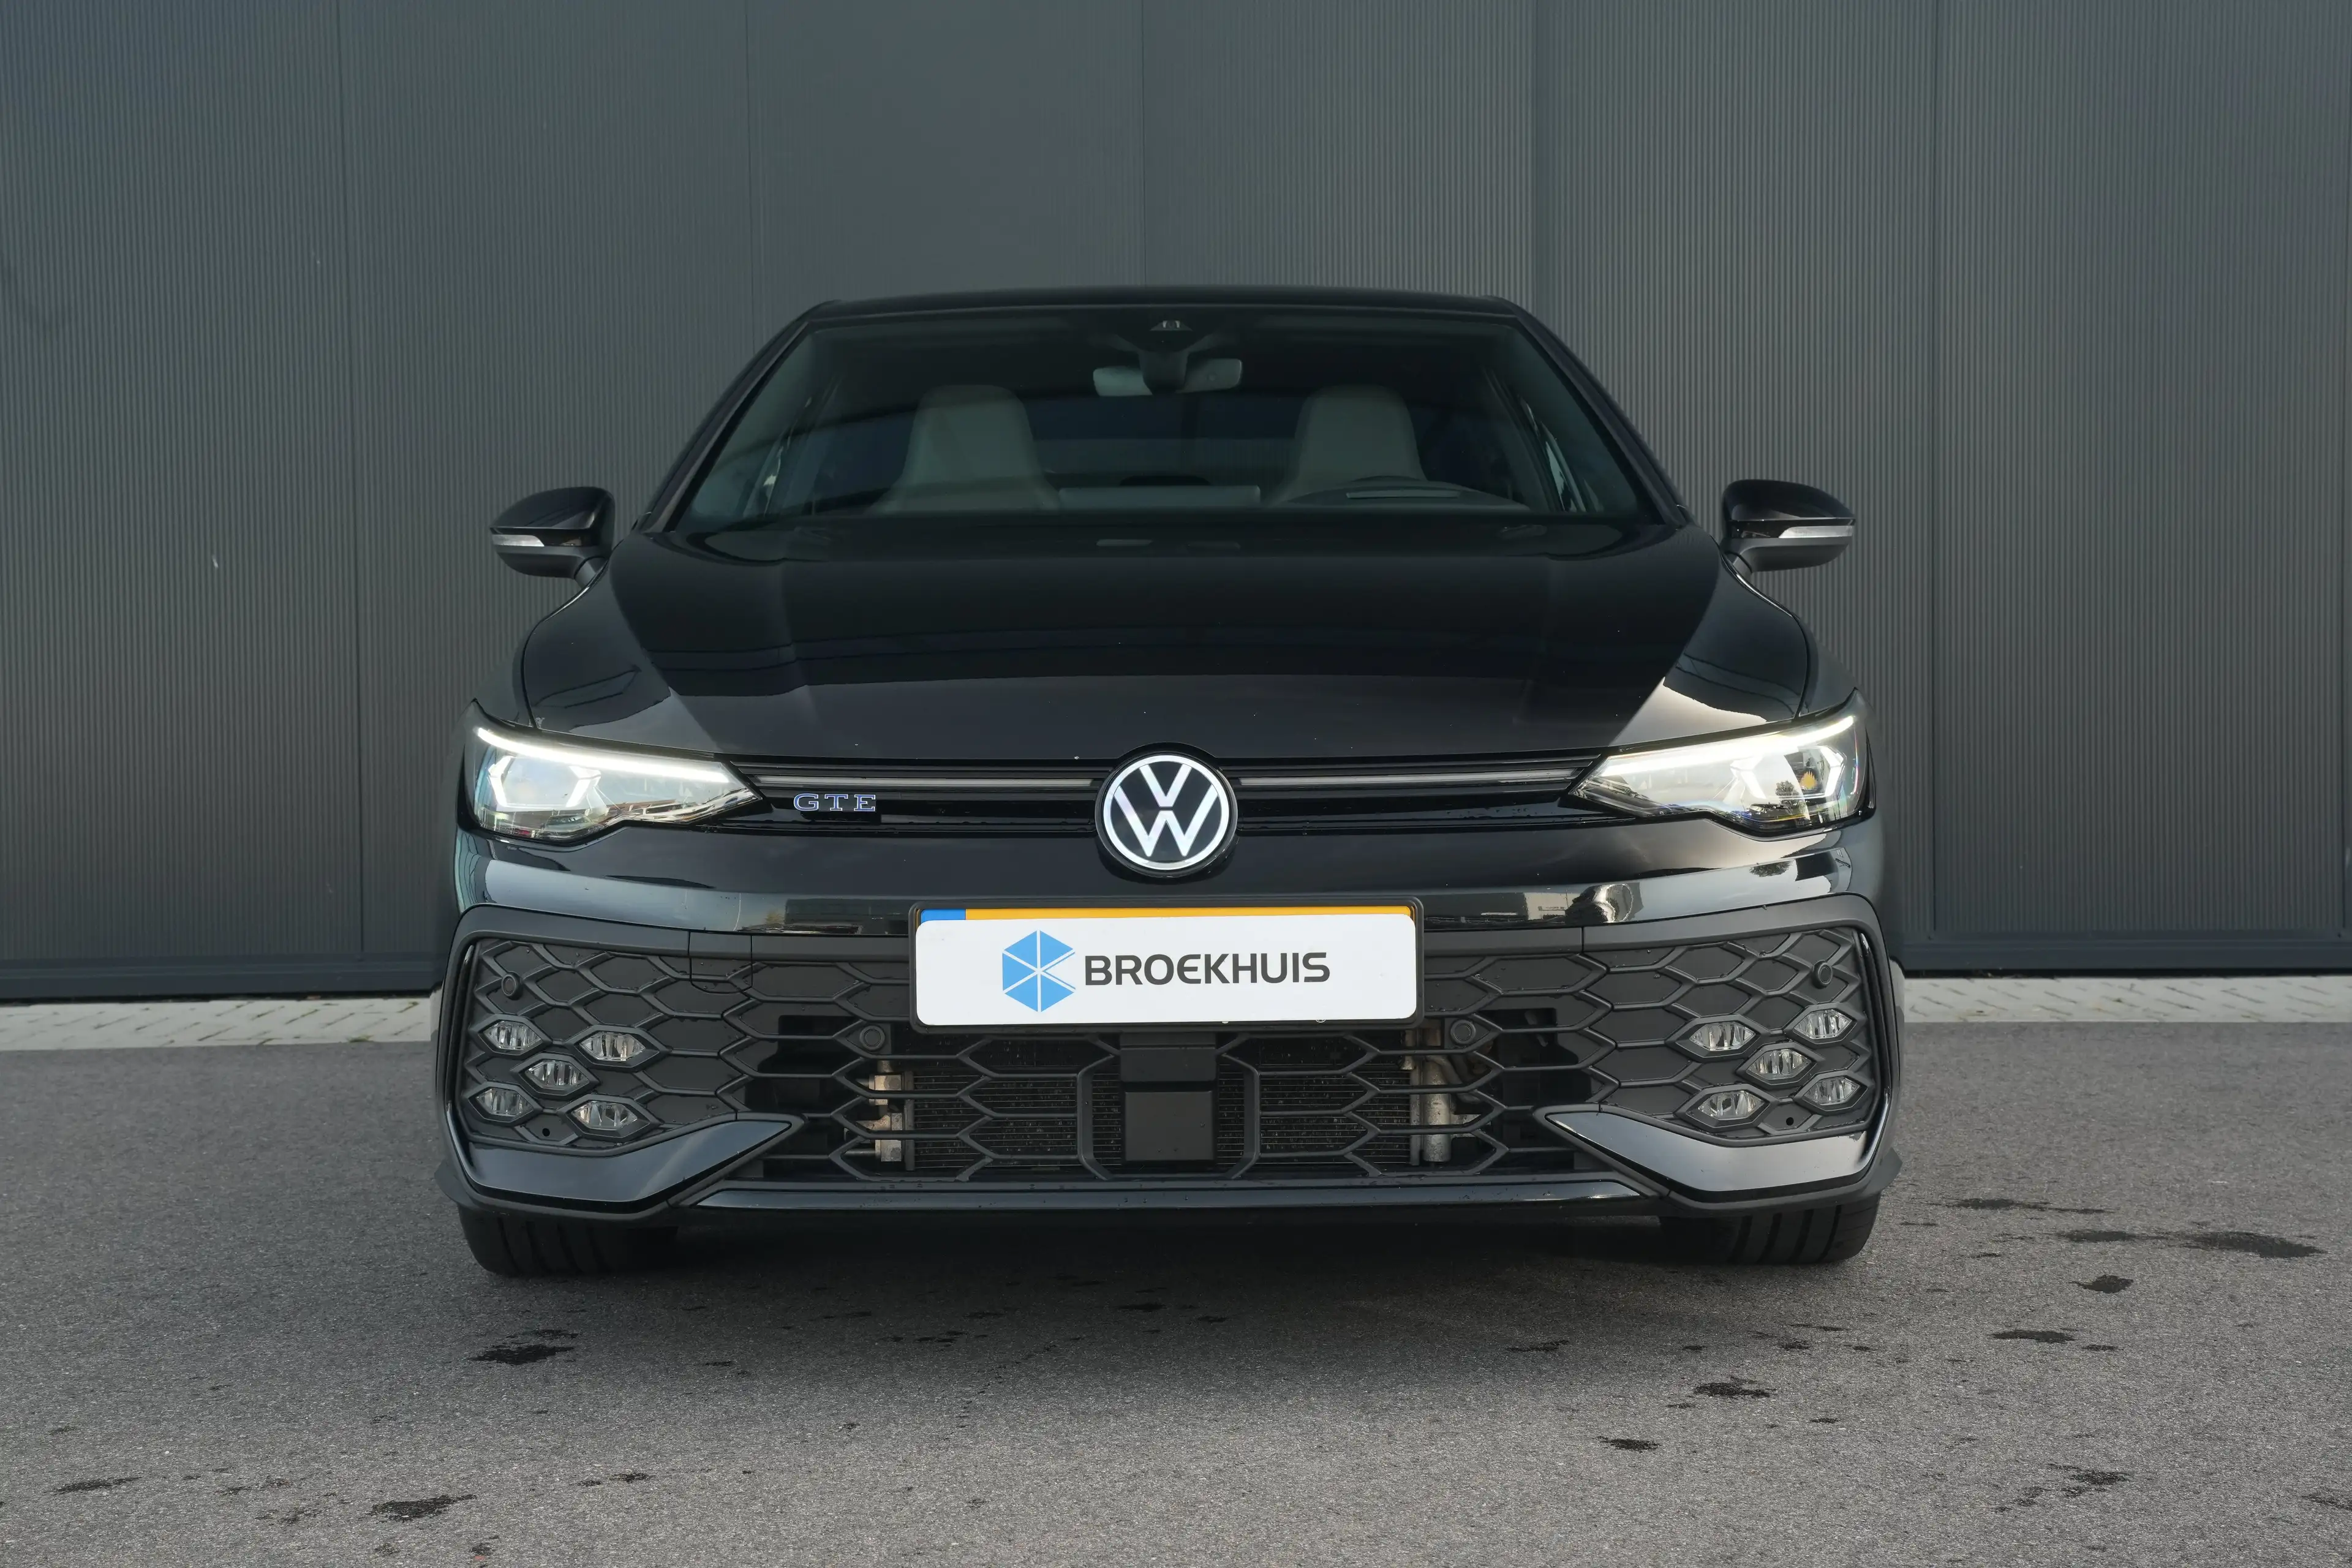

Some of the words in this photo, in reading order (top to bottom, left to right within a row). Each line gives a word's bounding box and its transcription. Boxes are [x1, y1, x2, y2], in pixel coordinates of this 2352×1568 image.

[793, 793, 876, 812] GTE
[1114, 764, 1218, 858] VW
[1085, 952, 1330, 986] BROEKHUIS
